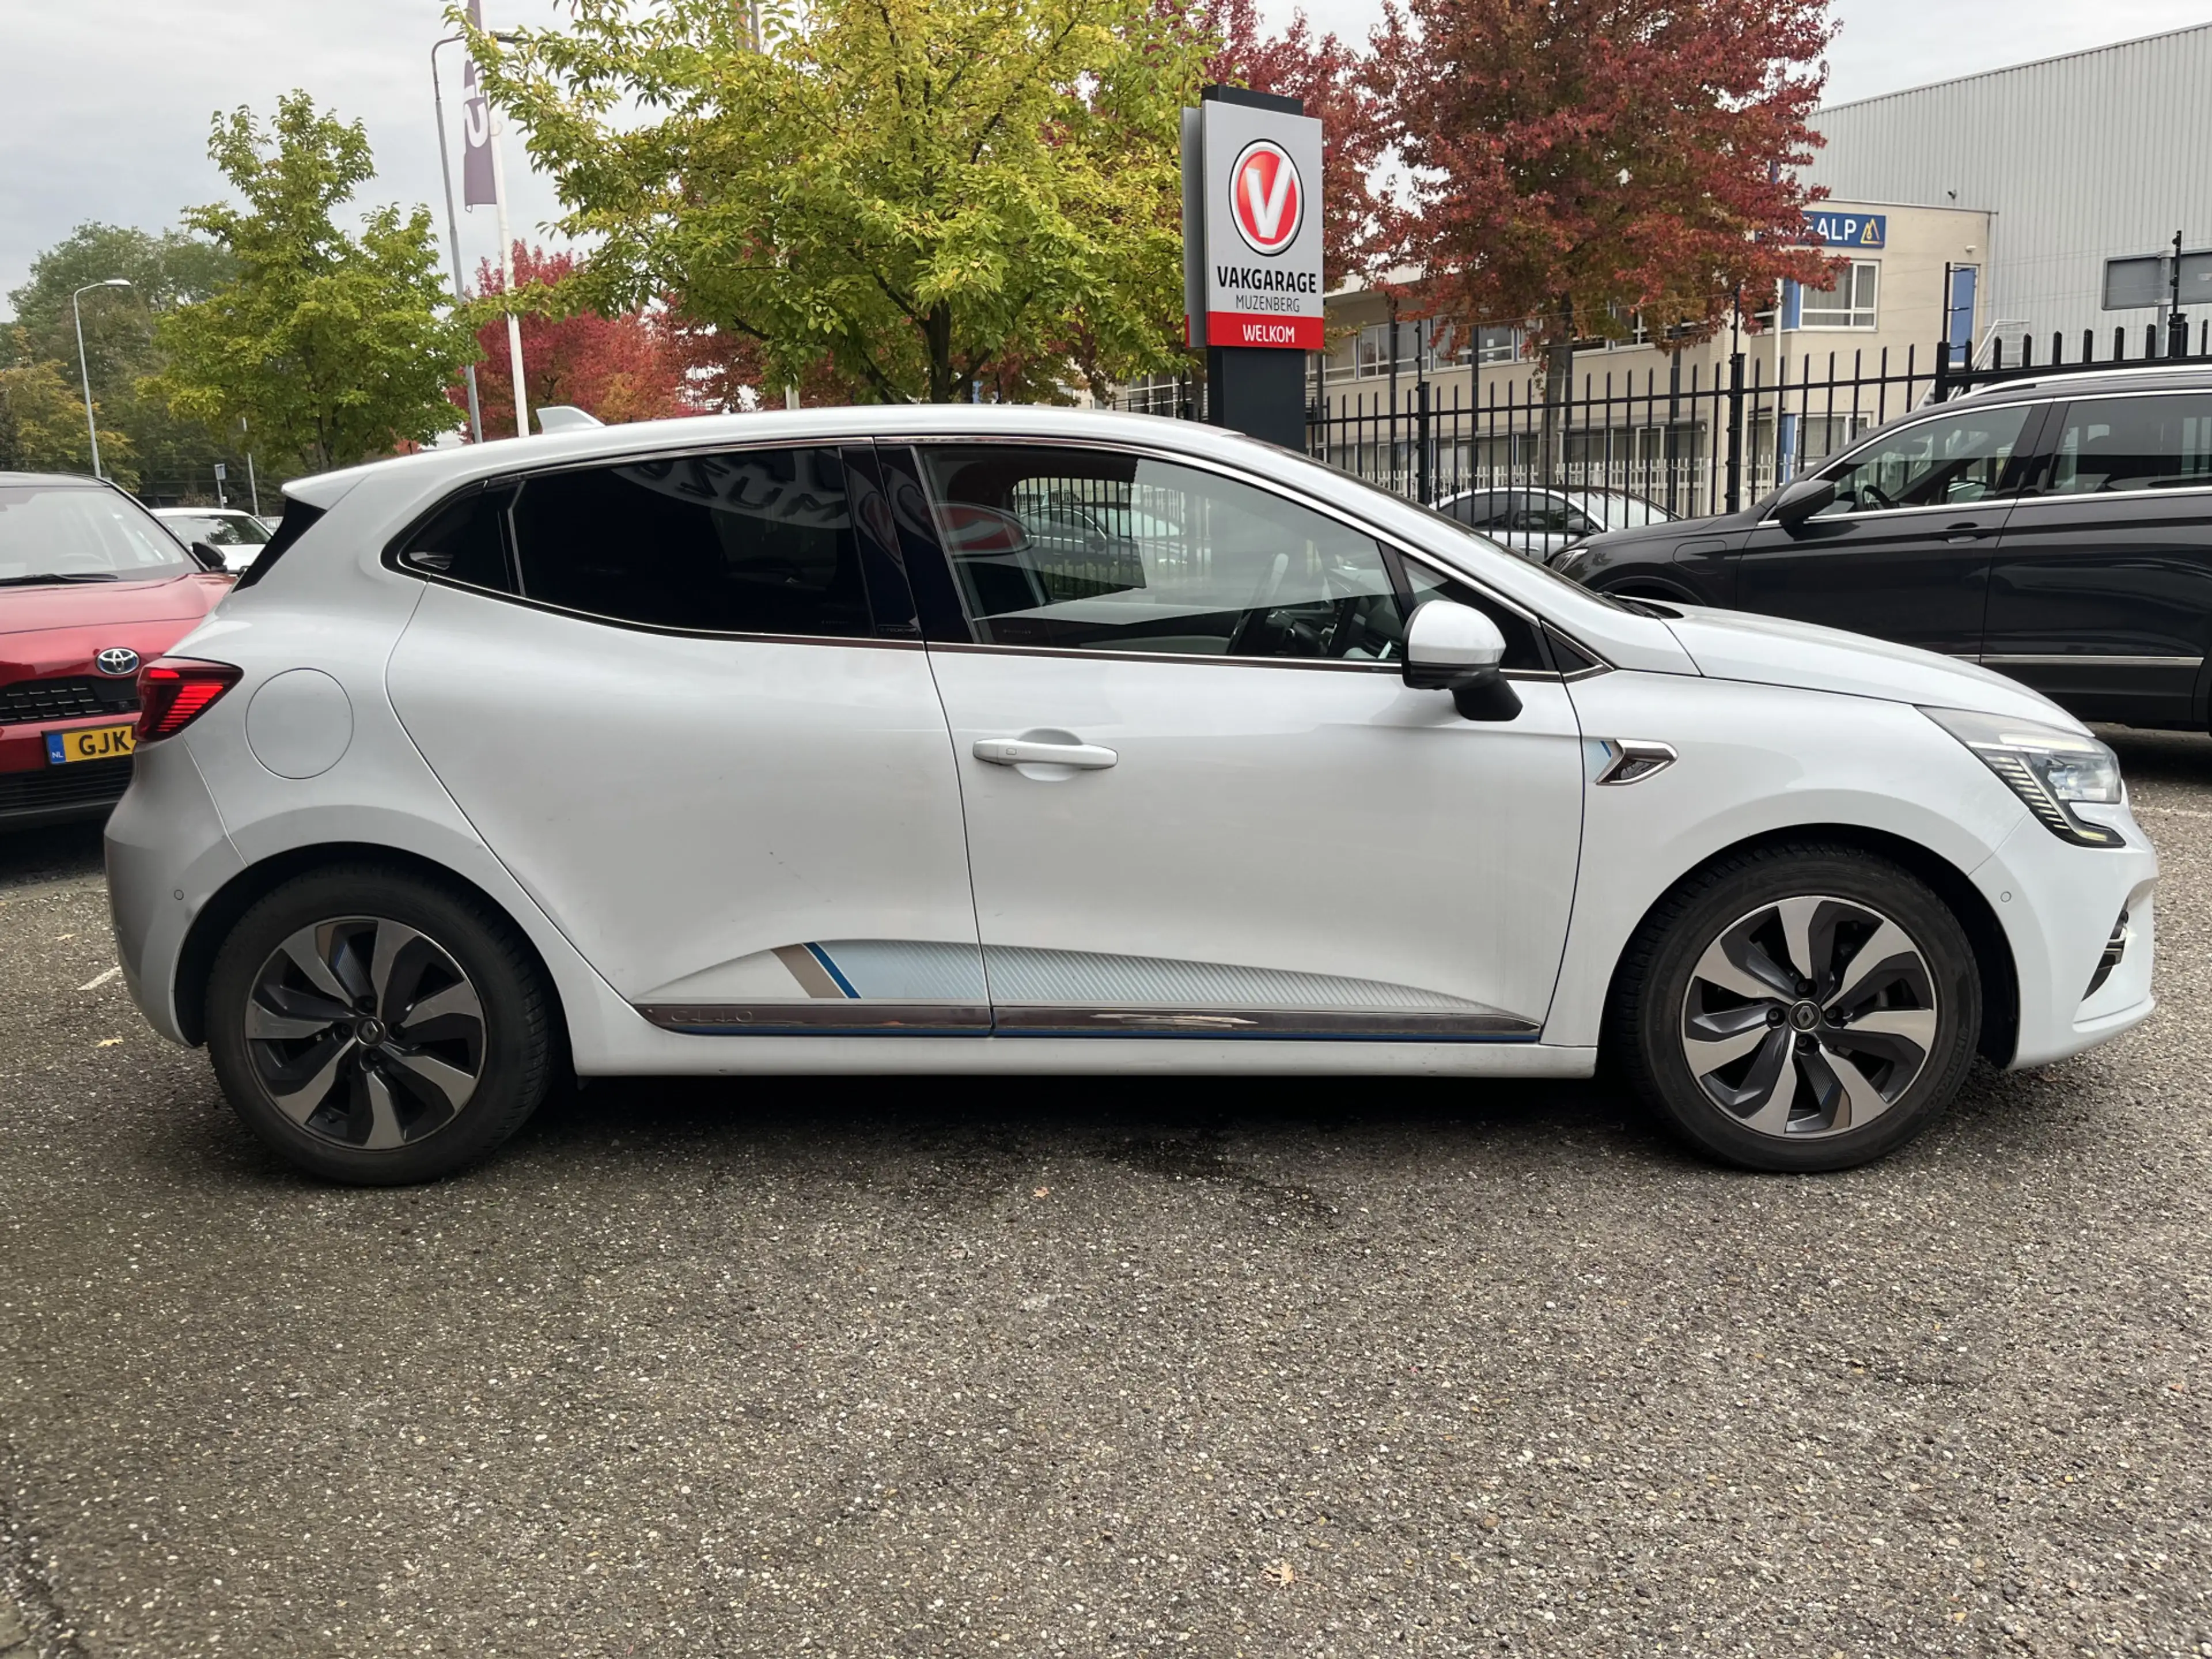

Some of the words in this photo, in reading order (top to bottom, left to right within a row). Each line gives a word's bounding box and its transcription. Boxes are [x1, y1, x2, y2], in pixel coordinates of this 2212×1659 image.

[1217, 266, 1316, 293] VAKGARAGE
[1236, 294, 1300, 312] MUZENBERG
[1243, 324, 1295, 343] WELKOM
[78, 730, 130, 755] GJK
